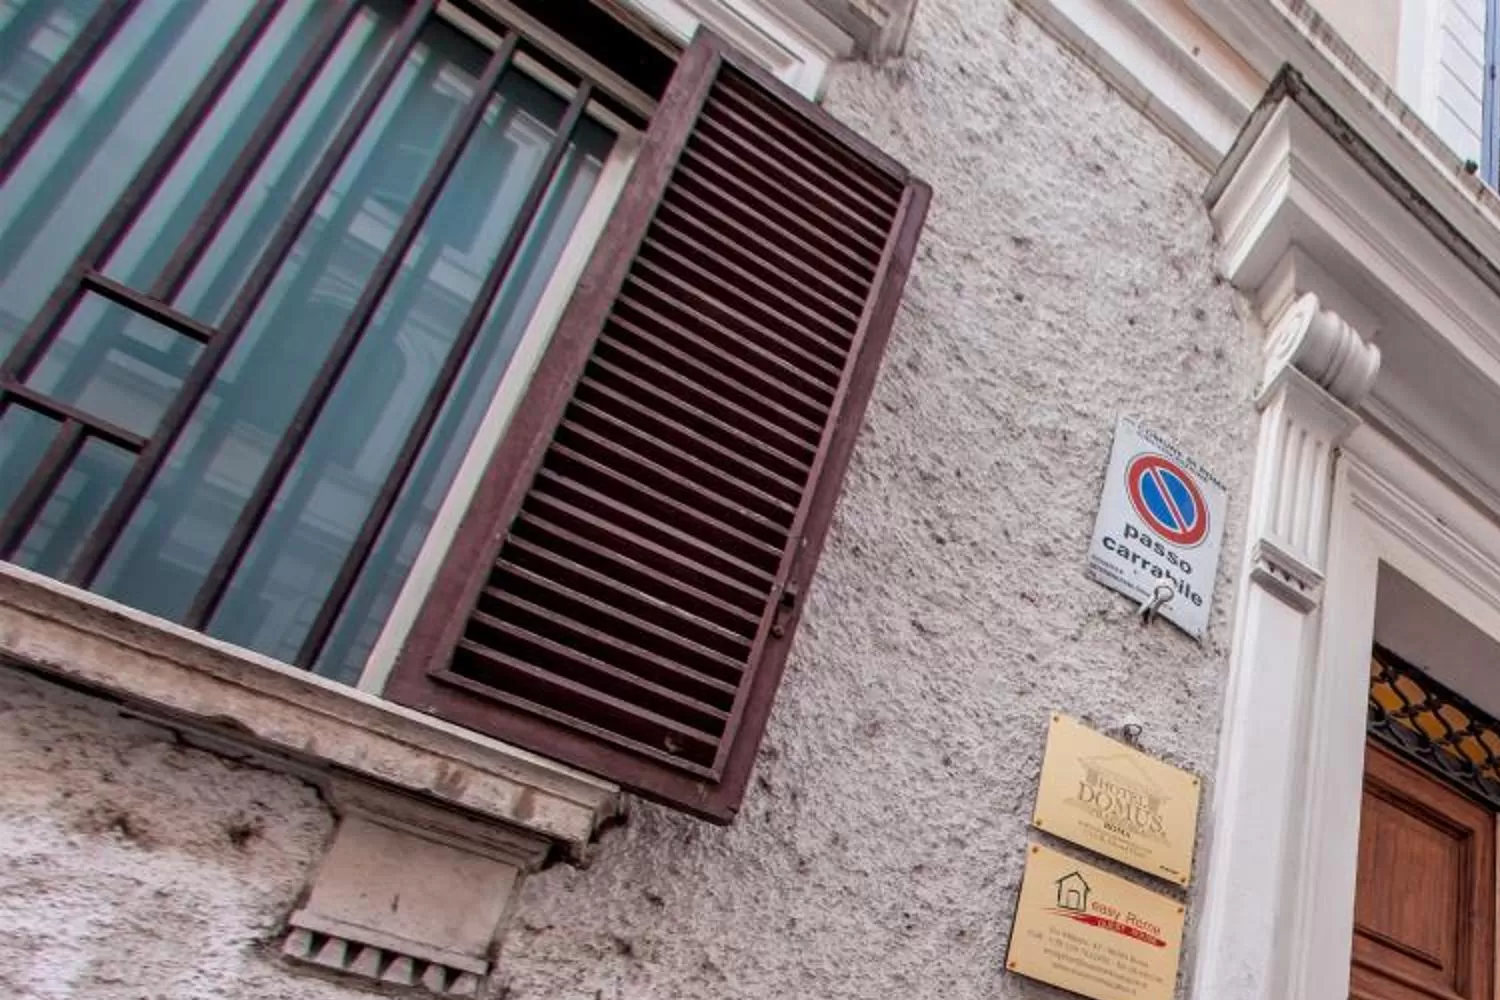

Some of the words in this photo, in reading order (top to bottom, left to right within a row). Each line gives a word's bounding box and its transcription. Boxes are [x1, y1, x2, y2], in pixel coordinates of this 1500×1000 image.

[1102, 536, 1204, 607] carrabile
[1123, 523, 1193, 576] passo
[1078, 781, 1163, 833] DOMUS
